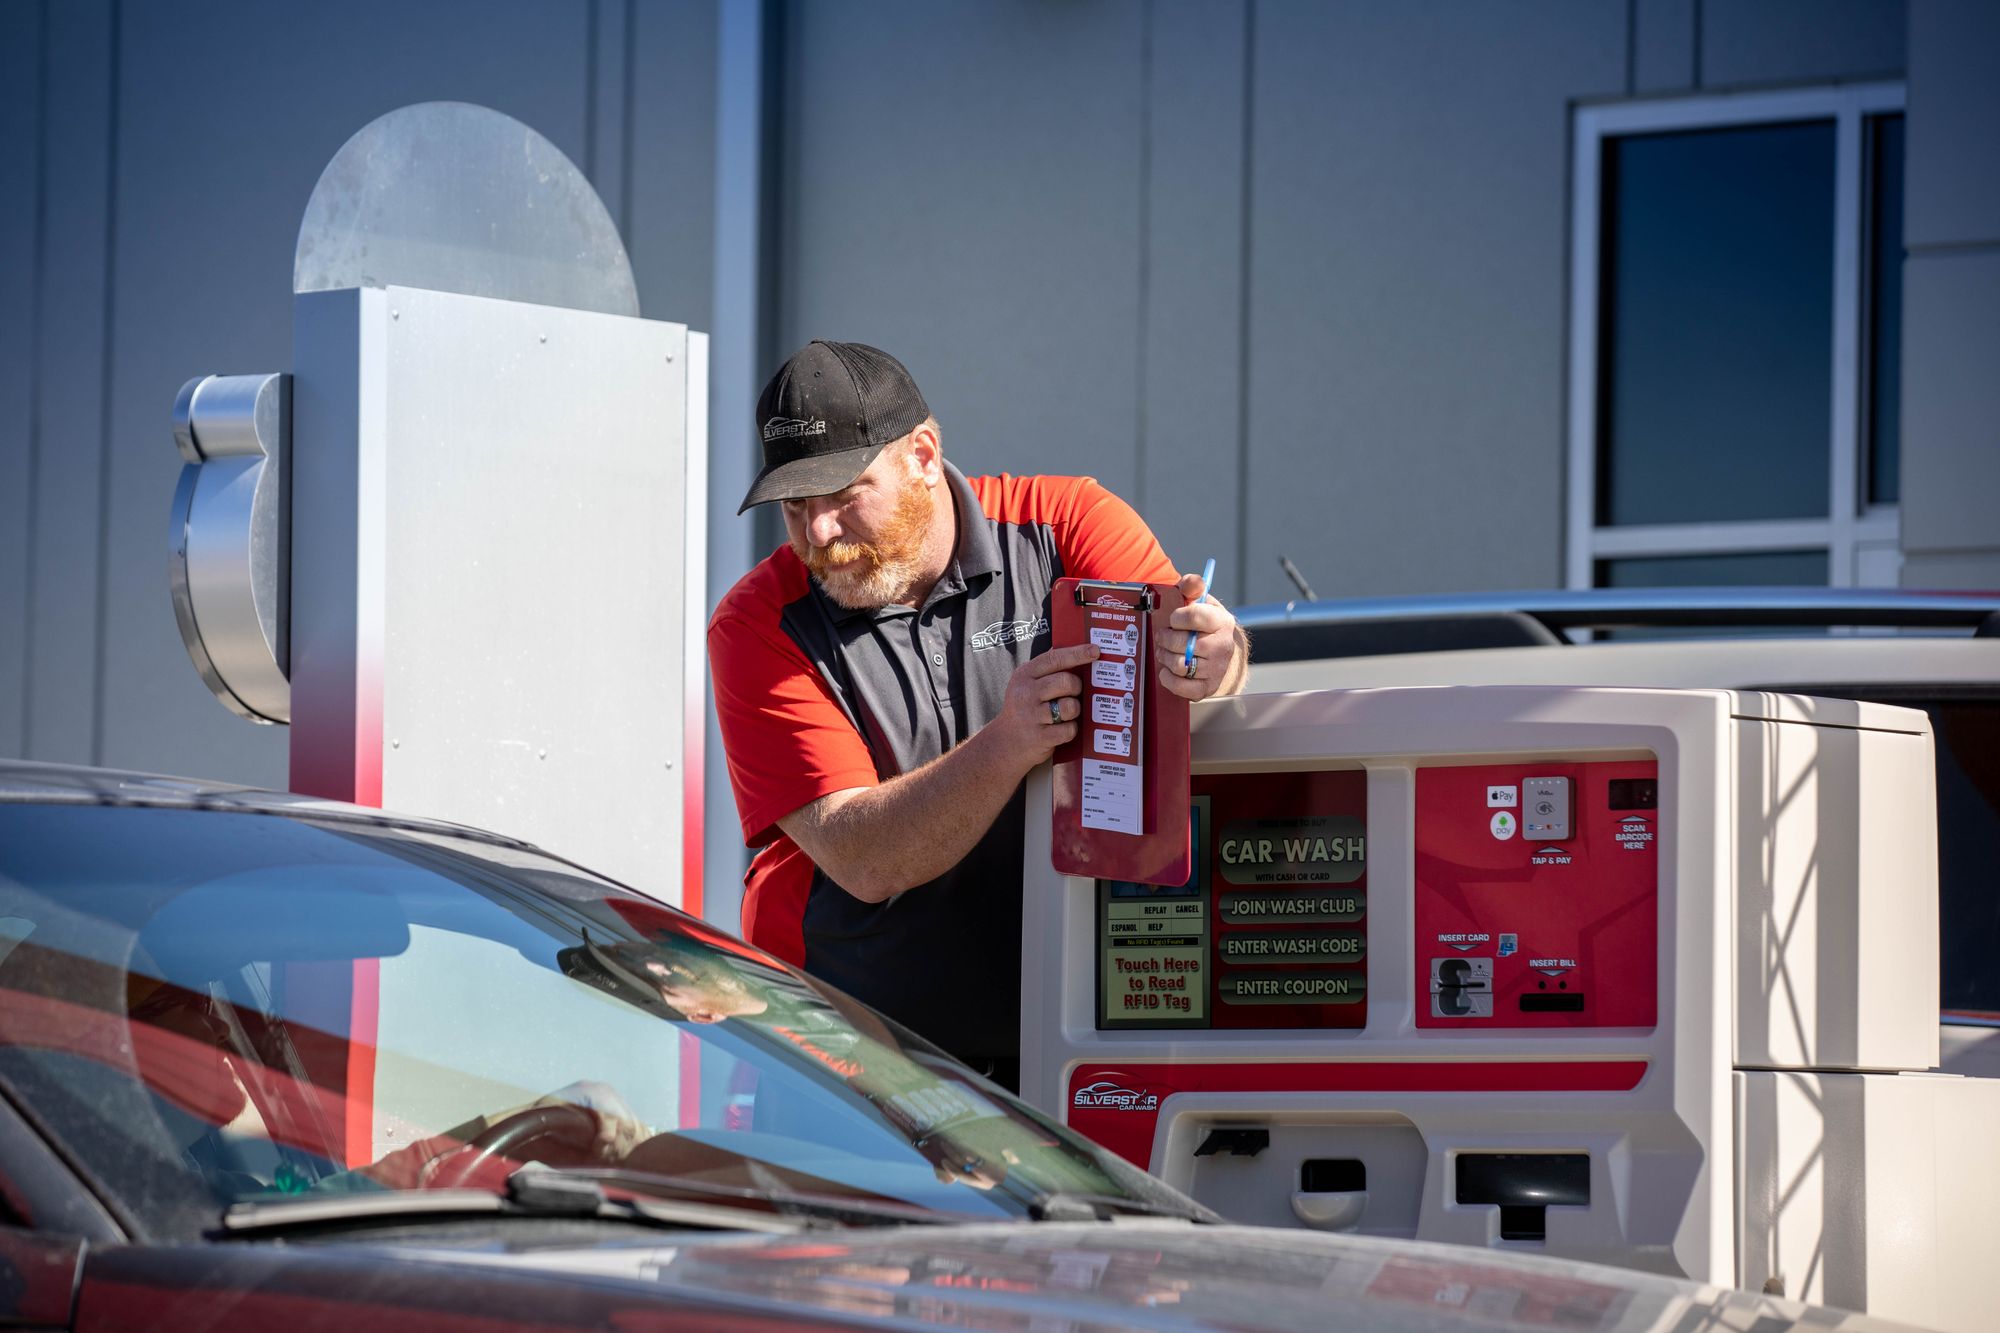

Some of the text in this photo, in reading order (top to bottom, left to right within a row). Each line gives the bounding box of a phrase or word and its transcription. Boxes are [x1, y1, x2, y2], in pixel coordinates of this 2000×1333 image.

[972, 615, 1049, 648] SILVERSTAR
[1499, 791, 1514, 802] Pay
[1622, 824, 1646, 833] SCAN
[1615, 833, 1653, 841] BARCODE
[1221, 836, 1366, 865] CAR WASH
[1532, 857, 1547, 865] TAP
[1256, 873, 1275, 881] WITH
[1276, 873, 1296, 881] CASH
[1310, 872, 1330, 881] CARD
[1144, 904, 1200, 915] REPLAY CANCEL
[1231, 898, 1356, 916] JOIN WASH CLUB
[1111, 923, 1164, 932] ESPANOL HELP
[1438, 934, 1490, 942] INSERT CARD
[1227, 938, 1359, 954] ENTER WASH CODE
[1115, 957, 1199, 971] Touch Here
[1529, 959, 1576, 967] INSERT BILL
[1129, 976, 1185, 990] to Read
[1236, 979, 1348, 995] ENTER COUPON
[1124, 994, 1190, 1011] RFID Tag
[1074, 1091, 1158, 1105] SILVERSTAR
